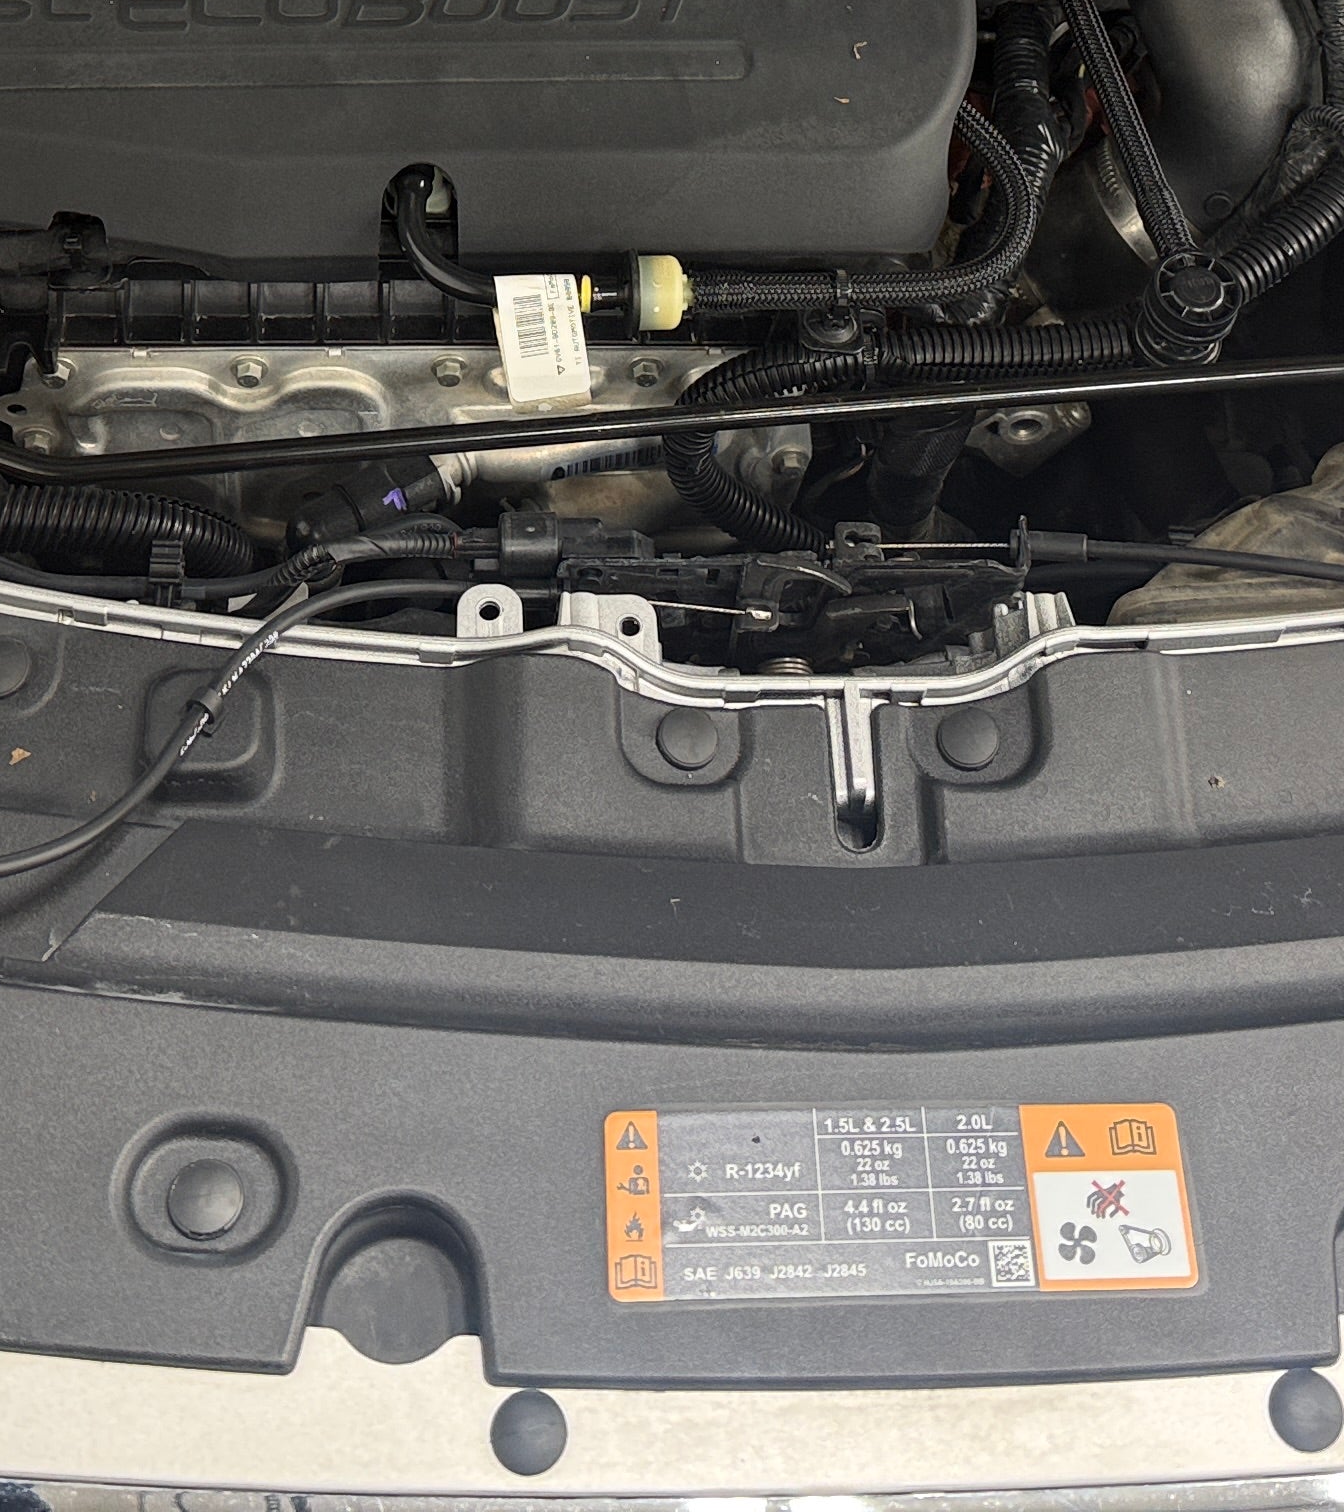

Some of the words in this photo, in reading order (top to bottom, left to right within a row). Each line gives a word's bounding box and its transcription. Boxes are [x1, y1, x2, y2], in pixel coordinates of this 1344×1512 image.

[823, 1117, 860, 1133] 1.5L
[863, 1117, 876, 1133] &
[880, 1116, 916, 1132] 2.5L
[956, 1115, 992, 1130] 2.0L
[840, 1140, 880, 1156] 0.625
[883, 1140, 903, 1159] kg
[946, 1138, 986, 1154] 0.625
[988, 1138, 1007, 1157] kg
[856, 1158, 872, 1171] 22
[874, 1160, 890, 1171] oz
[962, 1156, 977, 1169] 22
[980, 1157, 995, 1169] oz
[725, 1162, 801, 1181] R-1234yf
[850, 1173, 876, 1186] 1.38
[879, 1172, 899, 1186] lbs
[957, 1171, 982, 1185] 1.38
[984, 1171, 1004, 1184] lbs
[769, 1203, 807, 1219] PAG
[844, 1199, 869, 1214] 4.4
[872, 1199, 883, 1213] fl
[887, 1201, 908, 1213] oz
[951, 1198, 975, 1212] 2.7
[979, 1196, 991, 1211] fl
[994, 1199, 1014, 1211] oz
[705, 1223, 809, 1238] WSS-M2C300-A2
[846, 1217, 881, 1235] (130
[885, 1217, 910, 1234] cc)
[959, 1215, 984, 1233] (80
[988, 1214, 1013, 1231] cc)
[905, 1251, 980, 1268] FoMoCo
[683, 1266, 718, 1281] SAE
[725, 1266, 761, 1280] J639
[769, 1264, 813, 1279] J2842
[823, 1263, 867, 1277] J2845
